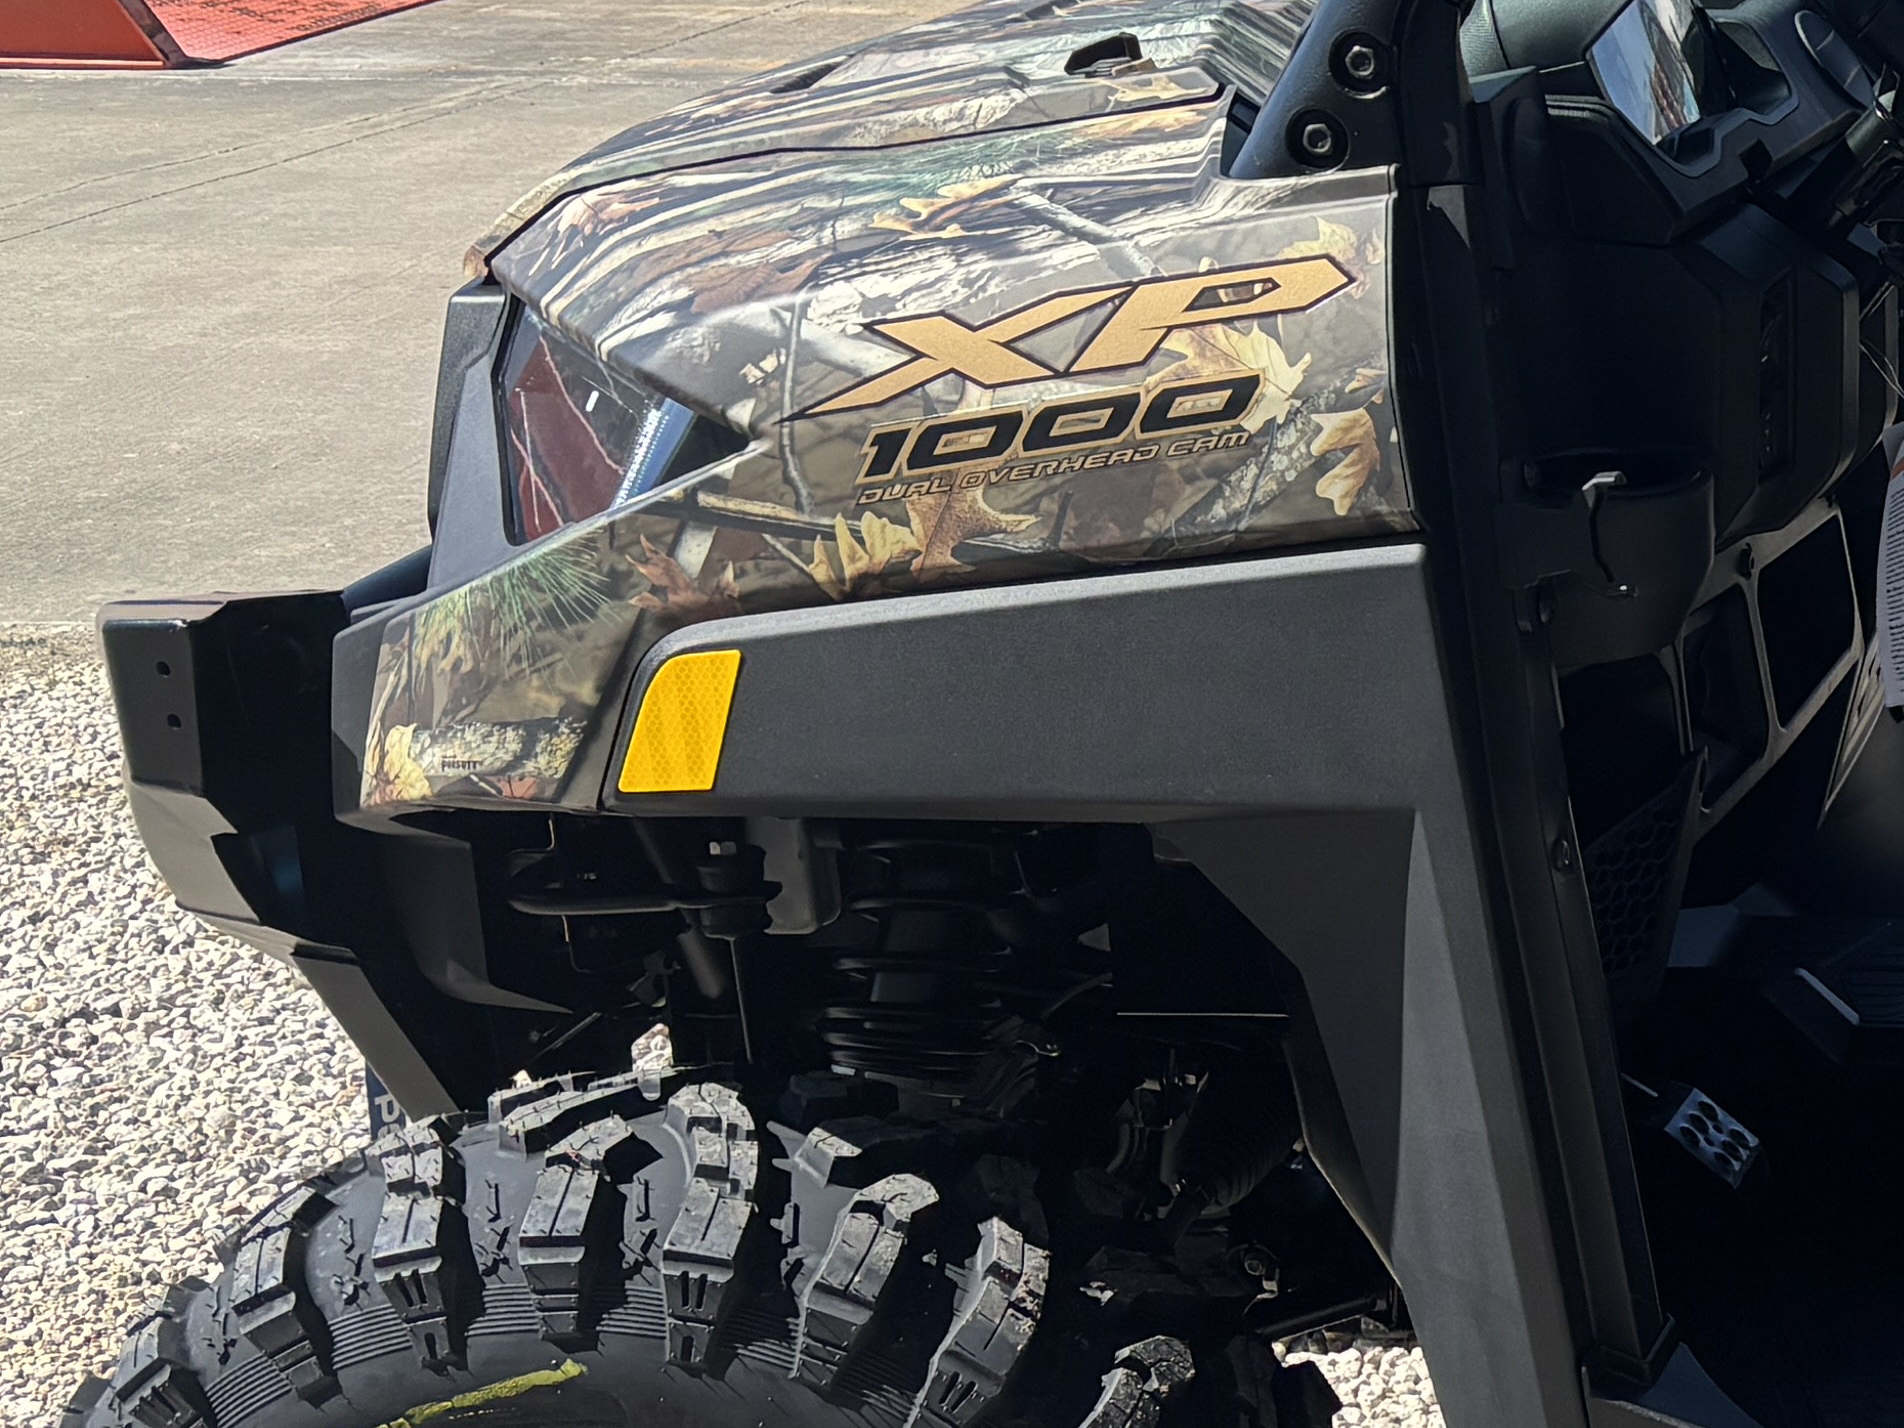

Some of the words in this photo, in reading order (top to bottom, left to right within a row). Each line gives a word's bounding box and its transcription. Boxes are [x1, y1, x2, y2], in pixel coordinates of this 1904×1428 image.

[777, 255, 1356, 421] XP
[857, 369, 1266, 483] 1000
[857, 478, 950, 505] DUAL
[959, 444, 1160, 489] OVERHEAD
[1167, 432, 1250, 457] CAM
